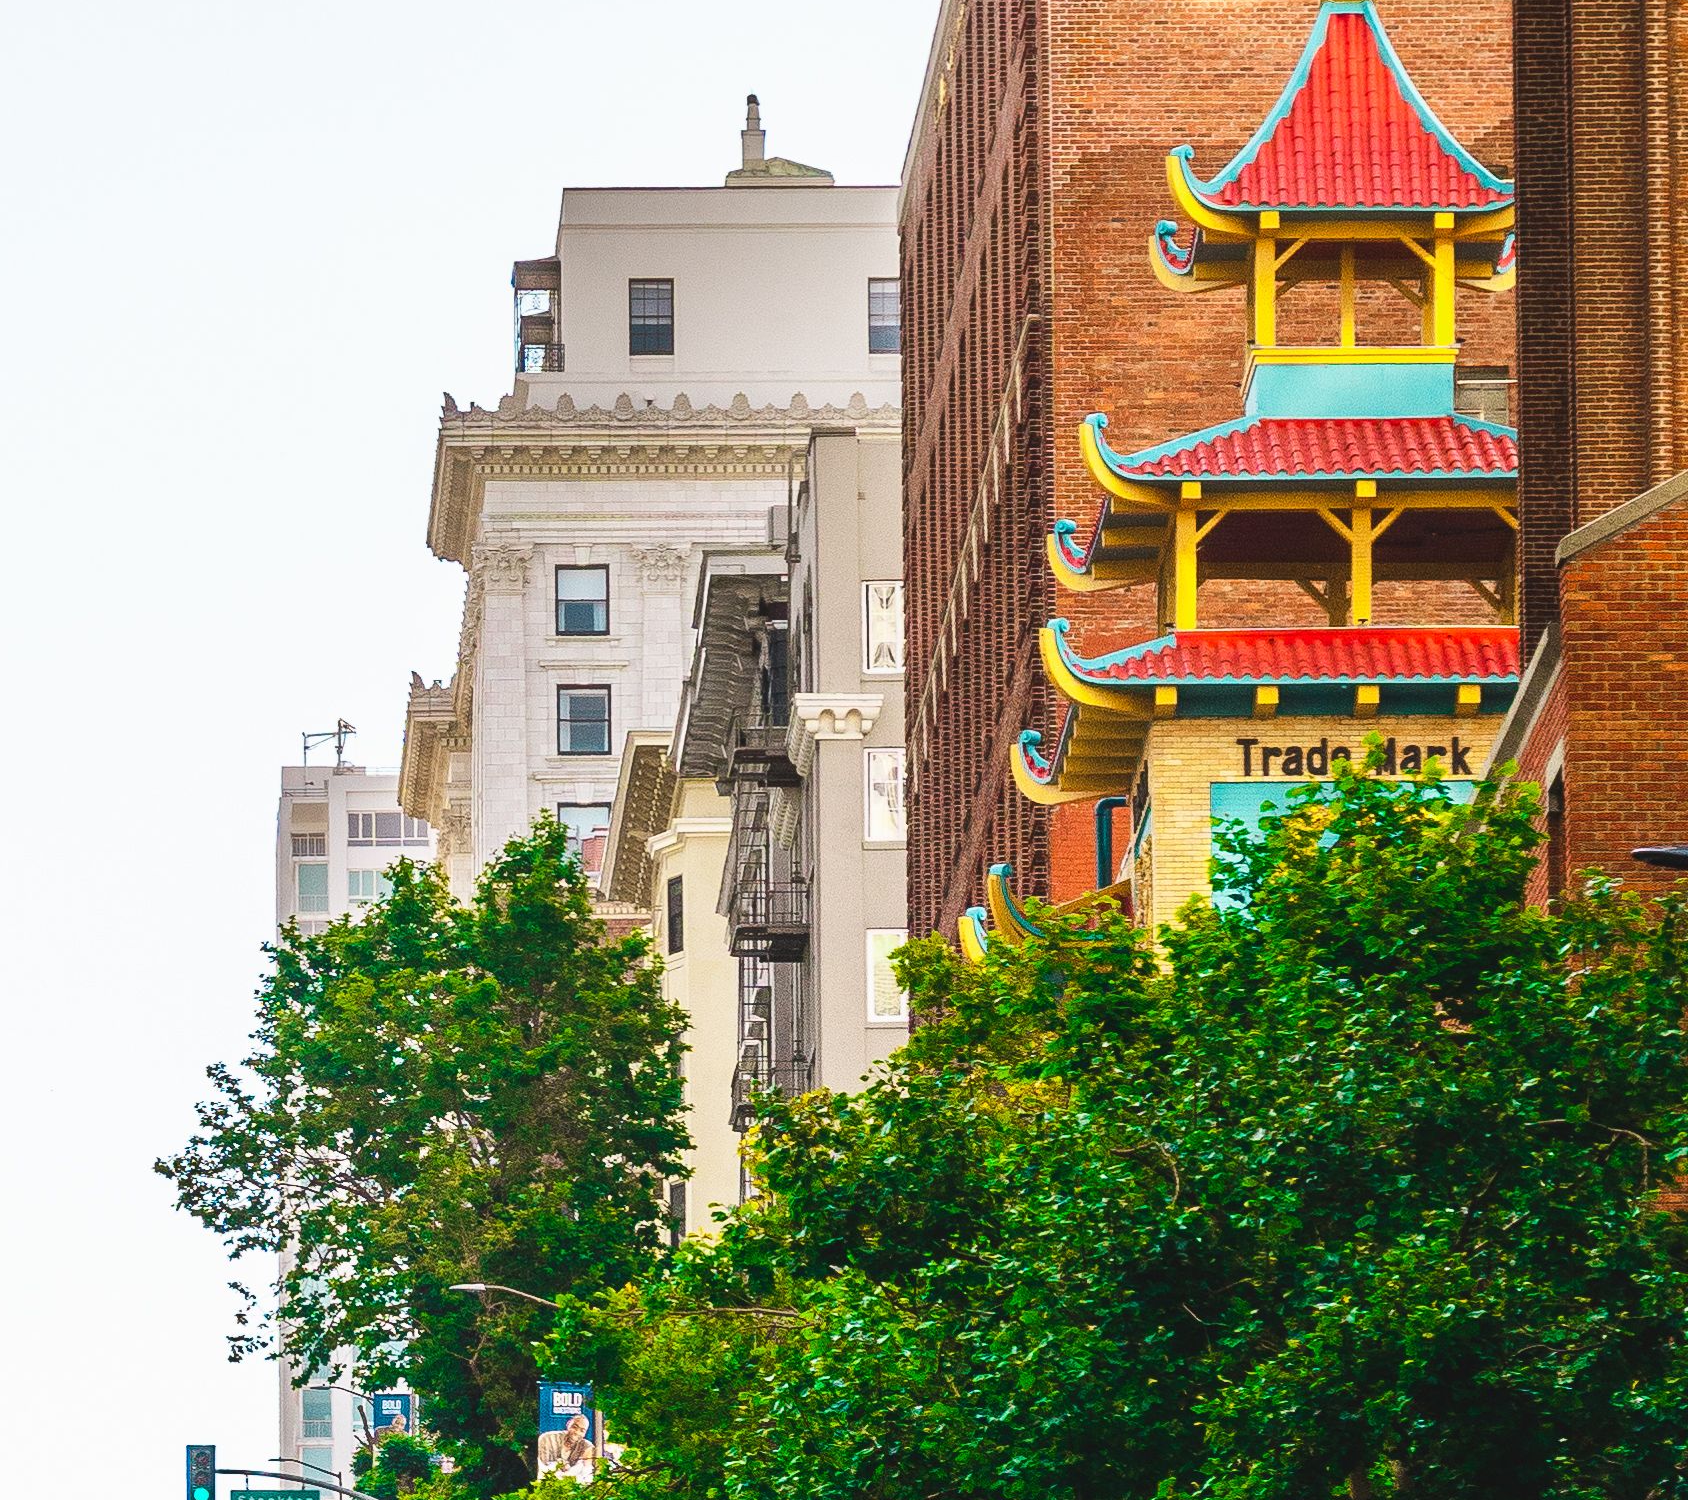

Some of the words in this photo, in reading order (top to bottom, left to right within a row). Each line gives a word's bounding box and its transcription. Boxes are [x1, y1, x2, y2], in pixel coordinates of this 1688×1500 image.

[1235, 737, 1352, 776] Trade
[1376, 736, 1473, 776] Mark
[381, 1399, 402, 1410] BOLD
[553, 1391, 583, 1408] BOLD
